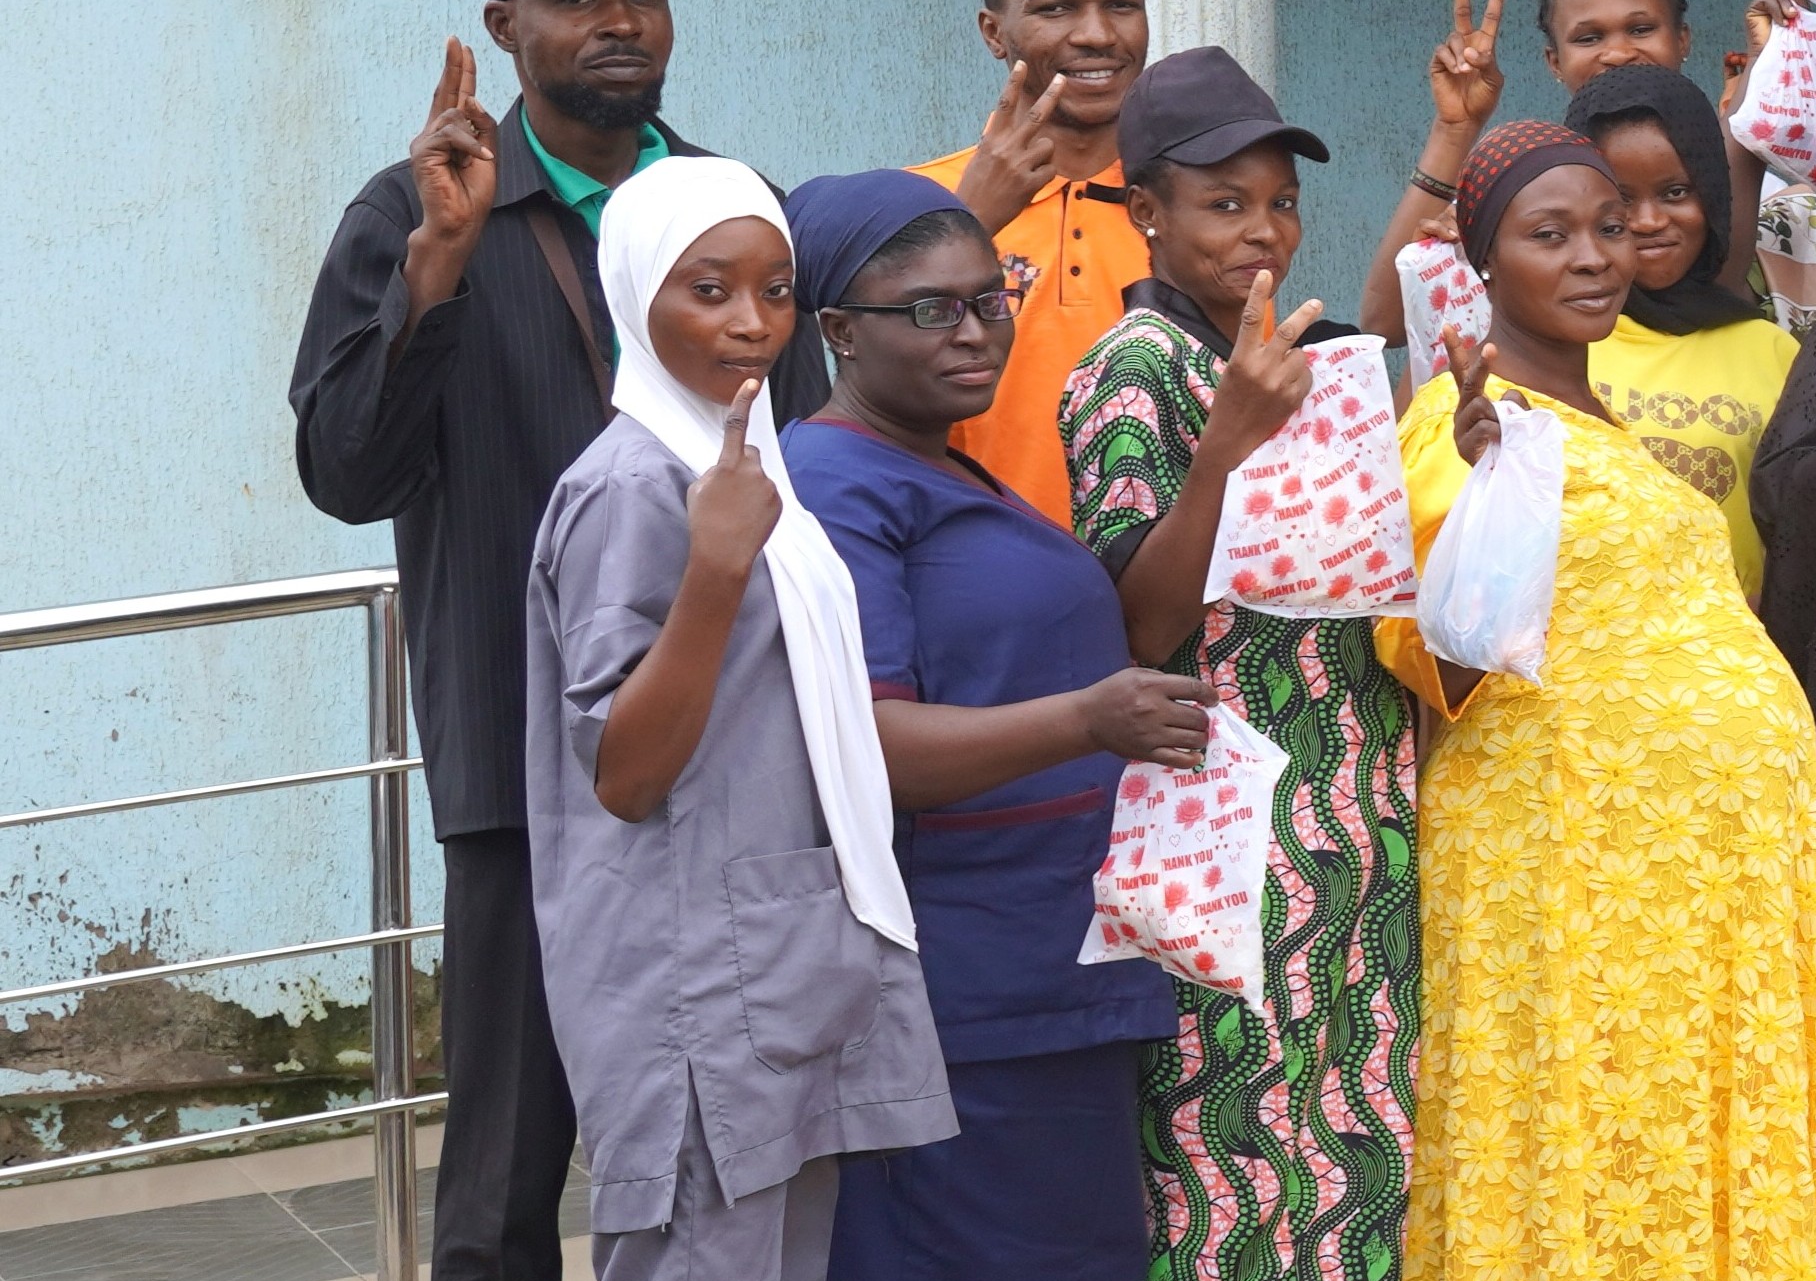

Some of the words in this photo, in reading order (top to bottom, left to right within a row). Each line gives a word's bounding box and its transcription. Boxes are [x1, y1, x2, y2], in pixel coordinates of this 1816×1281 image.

[1340, 421, 1370, 443] THANK
[1369, 410, 1390, 426] YOU
[1242, 465, 1277, 481] THANK
[1313, 468, 1343, 492] THANK
[1384, 488, 1403, 506] YOU
[1227, 543, 1262, 560] THANK
[1319, 548, 1353, 570] THANK
[1352, 538, 1373, 556] YOU
[1263, 582, 1297, 600] THANK
[1360, 577, 1393, 597] THANK
[1392, 567, 1414, 584] YOU
[1174, 771, 1208, 788] THANK
[1209, 767, 1229, 783] YOU
[1233, 806, 1253, 822] YOU
[1193, 847, 1213, 863] YOU
[1194, 900, 1224, 917] THANK
[1224, 891, 1248, 908] YOU
[1178, 934, 1199, 950] YOU
